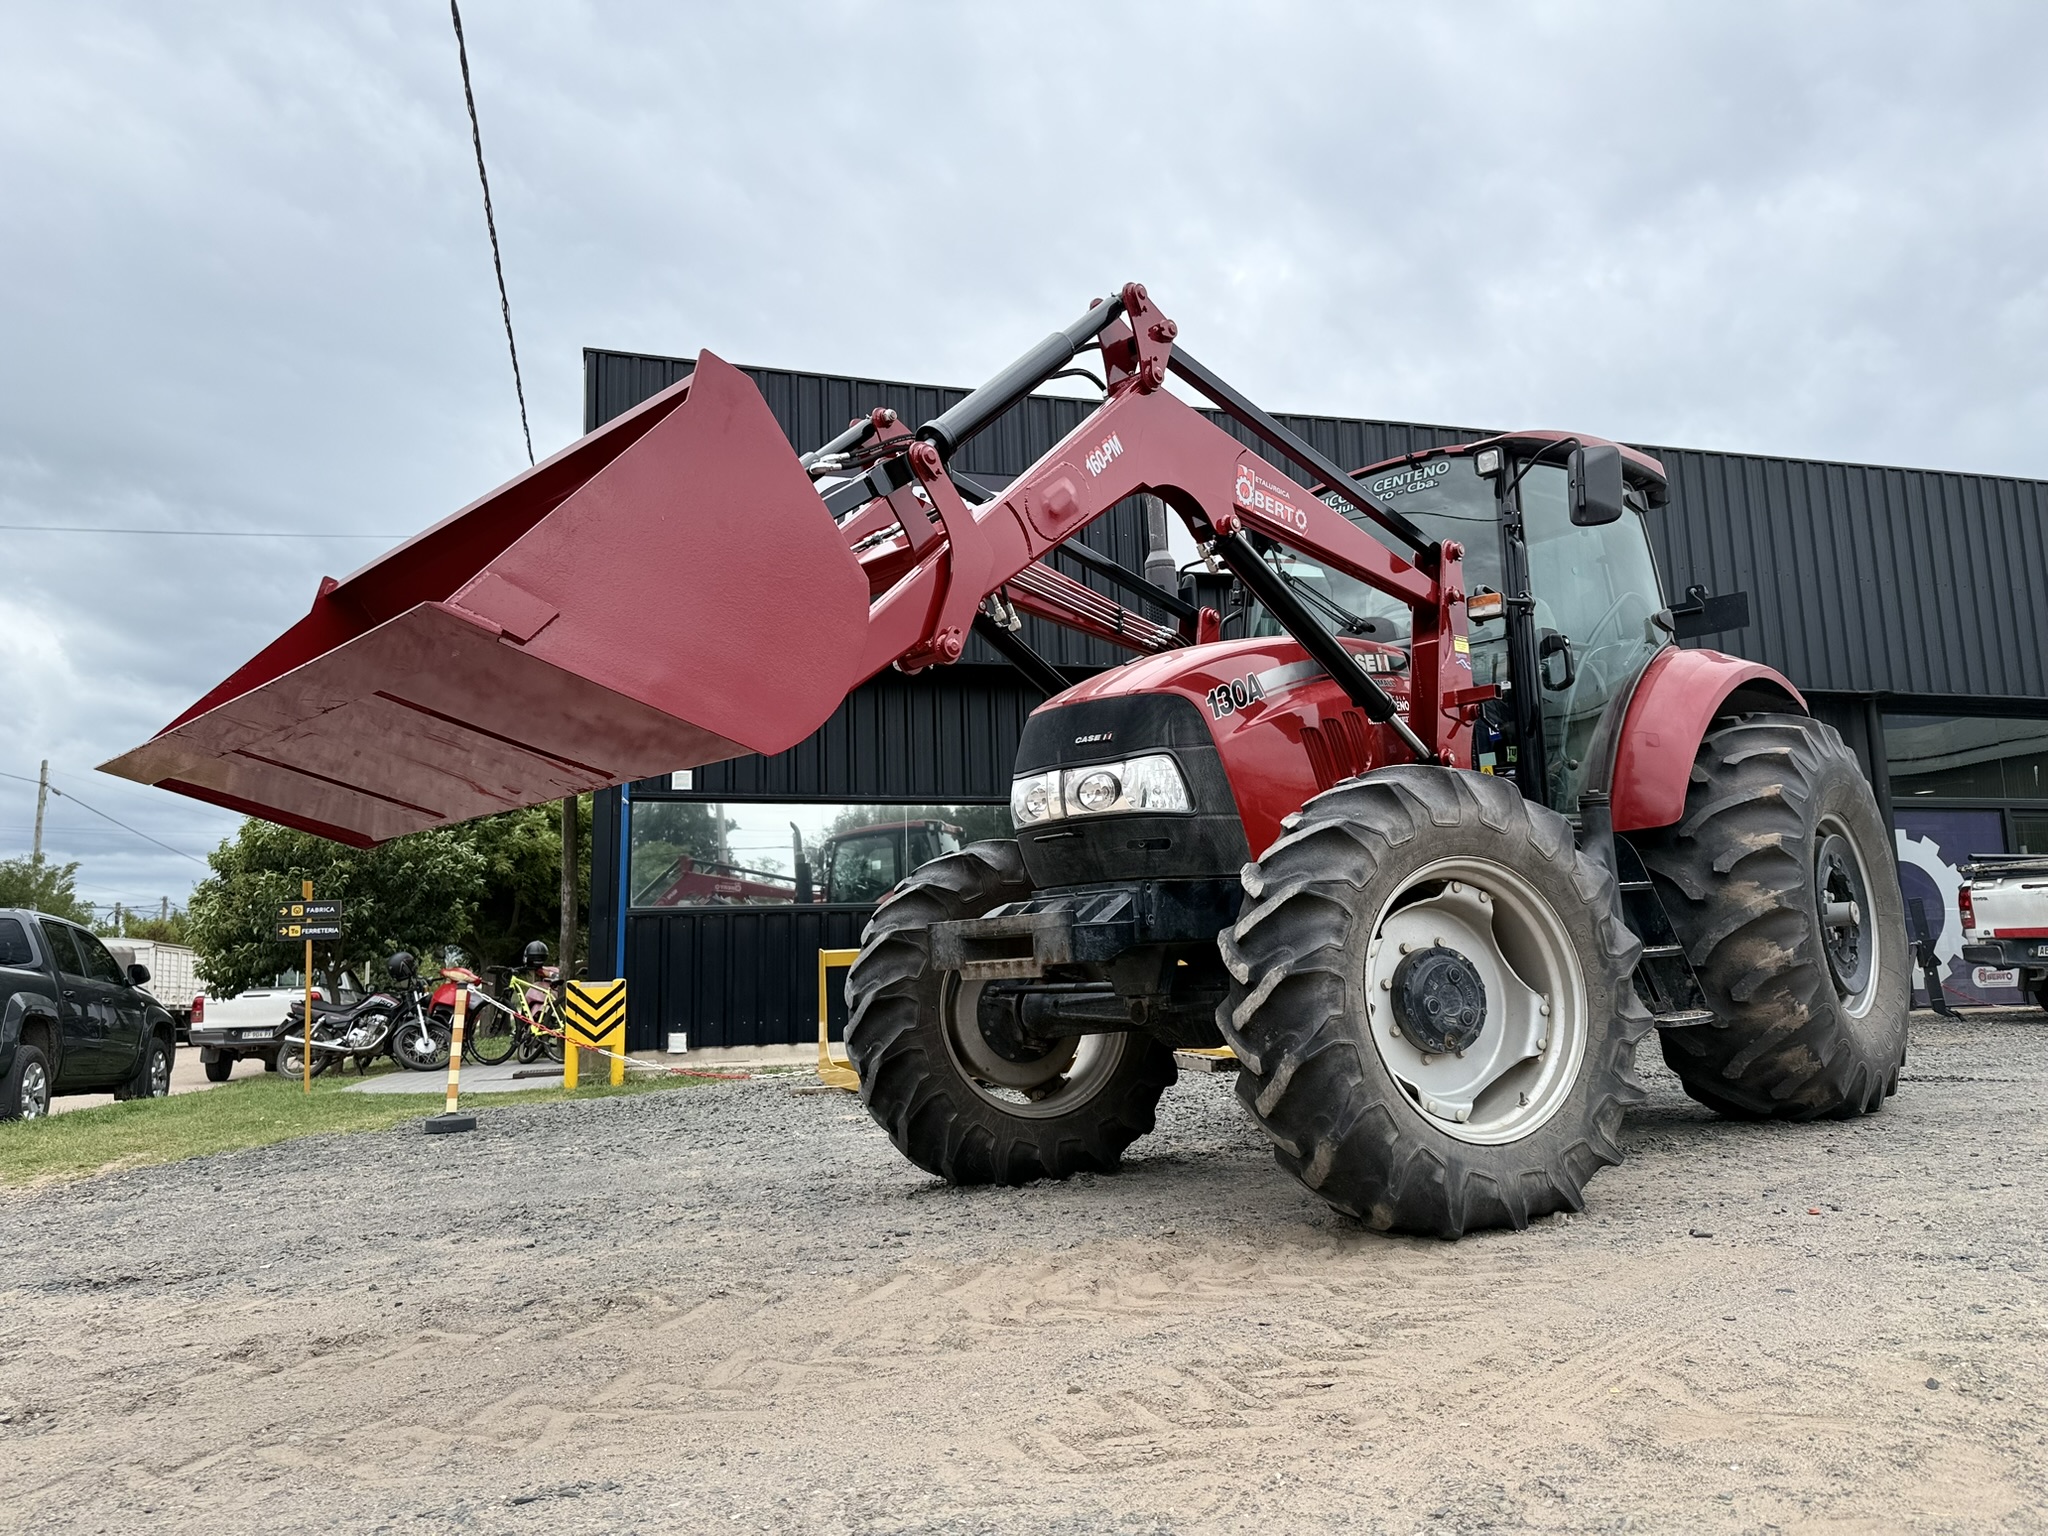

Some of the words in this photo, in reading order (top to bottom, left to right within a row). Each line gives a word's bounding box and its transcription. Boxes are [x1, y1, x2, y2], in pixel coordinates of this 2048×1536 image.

[1085, 433, 1124, 478] 160-PM
[1372, 461, 1451, 493] CENTENO
[1406, 479, 1439, 493] Cba.
[1235, 475, 1308, 530] OBERTO
[1205, 671, 1267, 721] 130A
[1074, 733, 1101, 744] CASE
[306, 906, 335, 914] FABRICA
[301, 927, 339, 935] FERRETERIA
